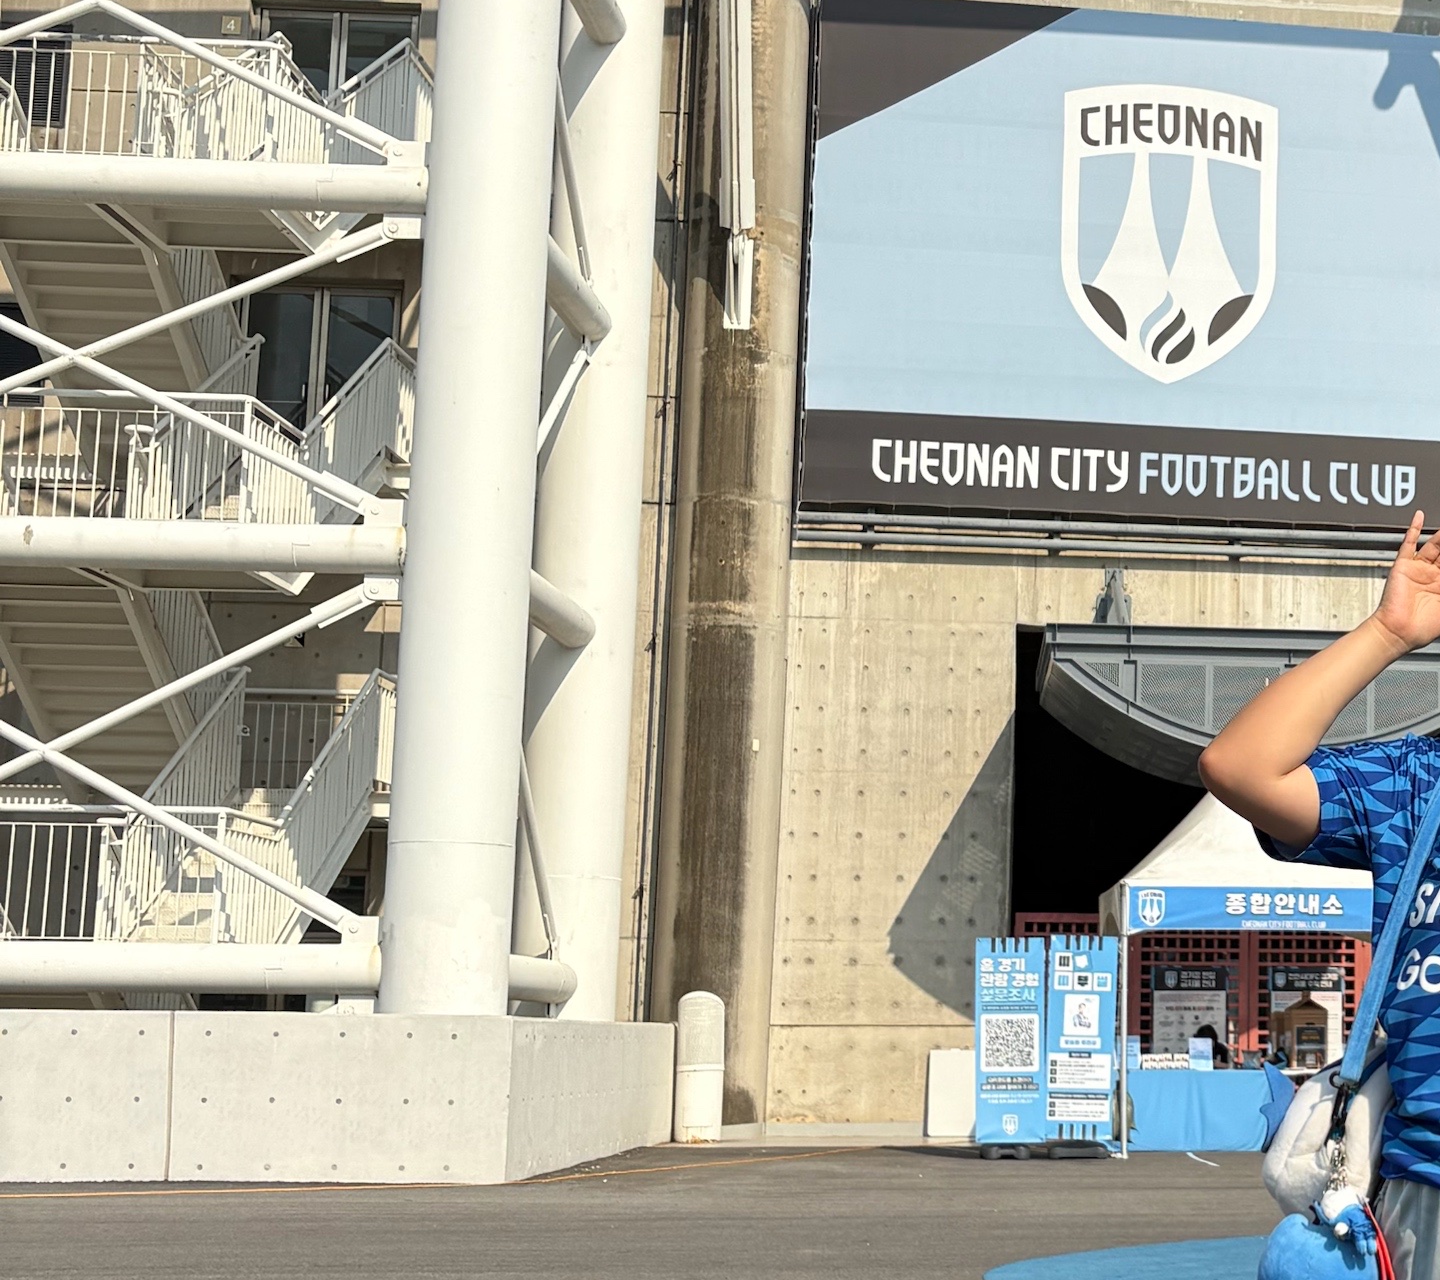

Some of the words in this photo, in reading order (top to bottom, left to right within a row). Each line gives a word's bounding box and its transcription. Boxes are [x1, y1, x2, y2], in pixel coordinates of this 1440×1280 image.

[226, 19, 236, 32] 4
[1079, 102, 1263, 162] CHEONAN
[870, 437, 1040, 490] CHEONAN
[1050, 446, 1131, 494] CITY
[1138, 451, 1322, 503] FOOTBALL
[1328, 463, 1417, 507] CLUB
[1225, 892, 1344, 916] 종합안내소
[997, 957, 1026, 973] 경기
[980, 987, 1036, 1003] 설문조사
